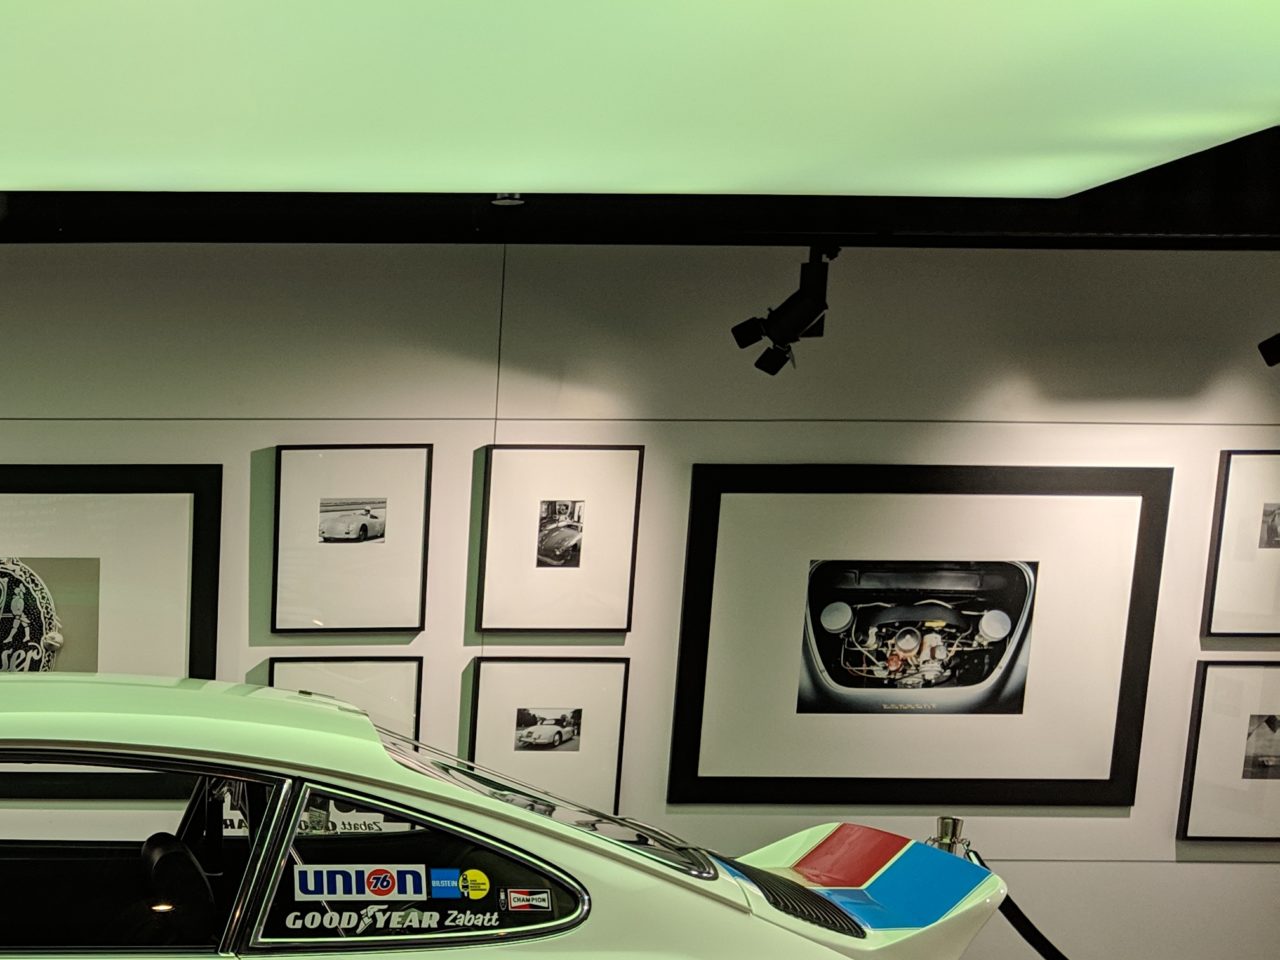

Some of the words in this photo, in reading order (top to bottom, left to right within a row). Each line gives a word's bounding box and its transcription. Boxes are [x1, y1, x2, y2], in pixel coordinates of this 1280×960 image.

[370, 874, 392, 890] 76
[512, 895, 547, 904] CHAMPION
[444, 910, 500, 927] Zabatt
